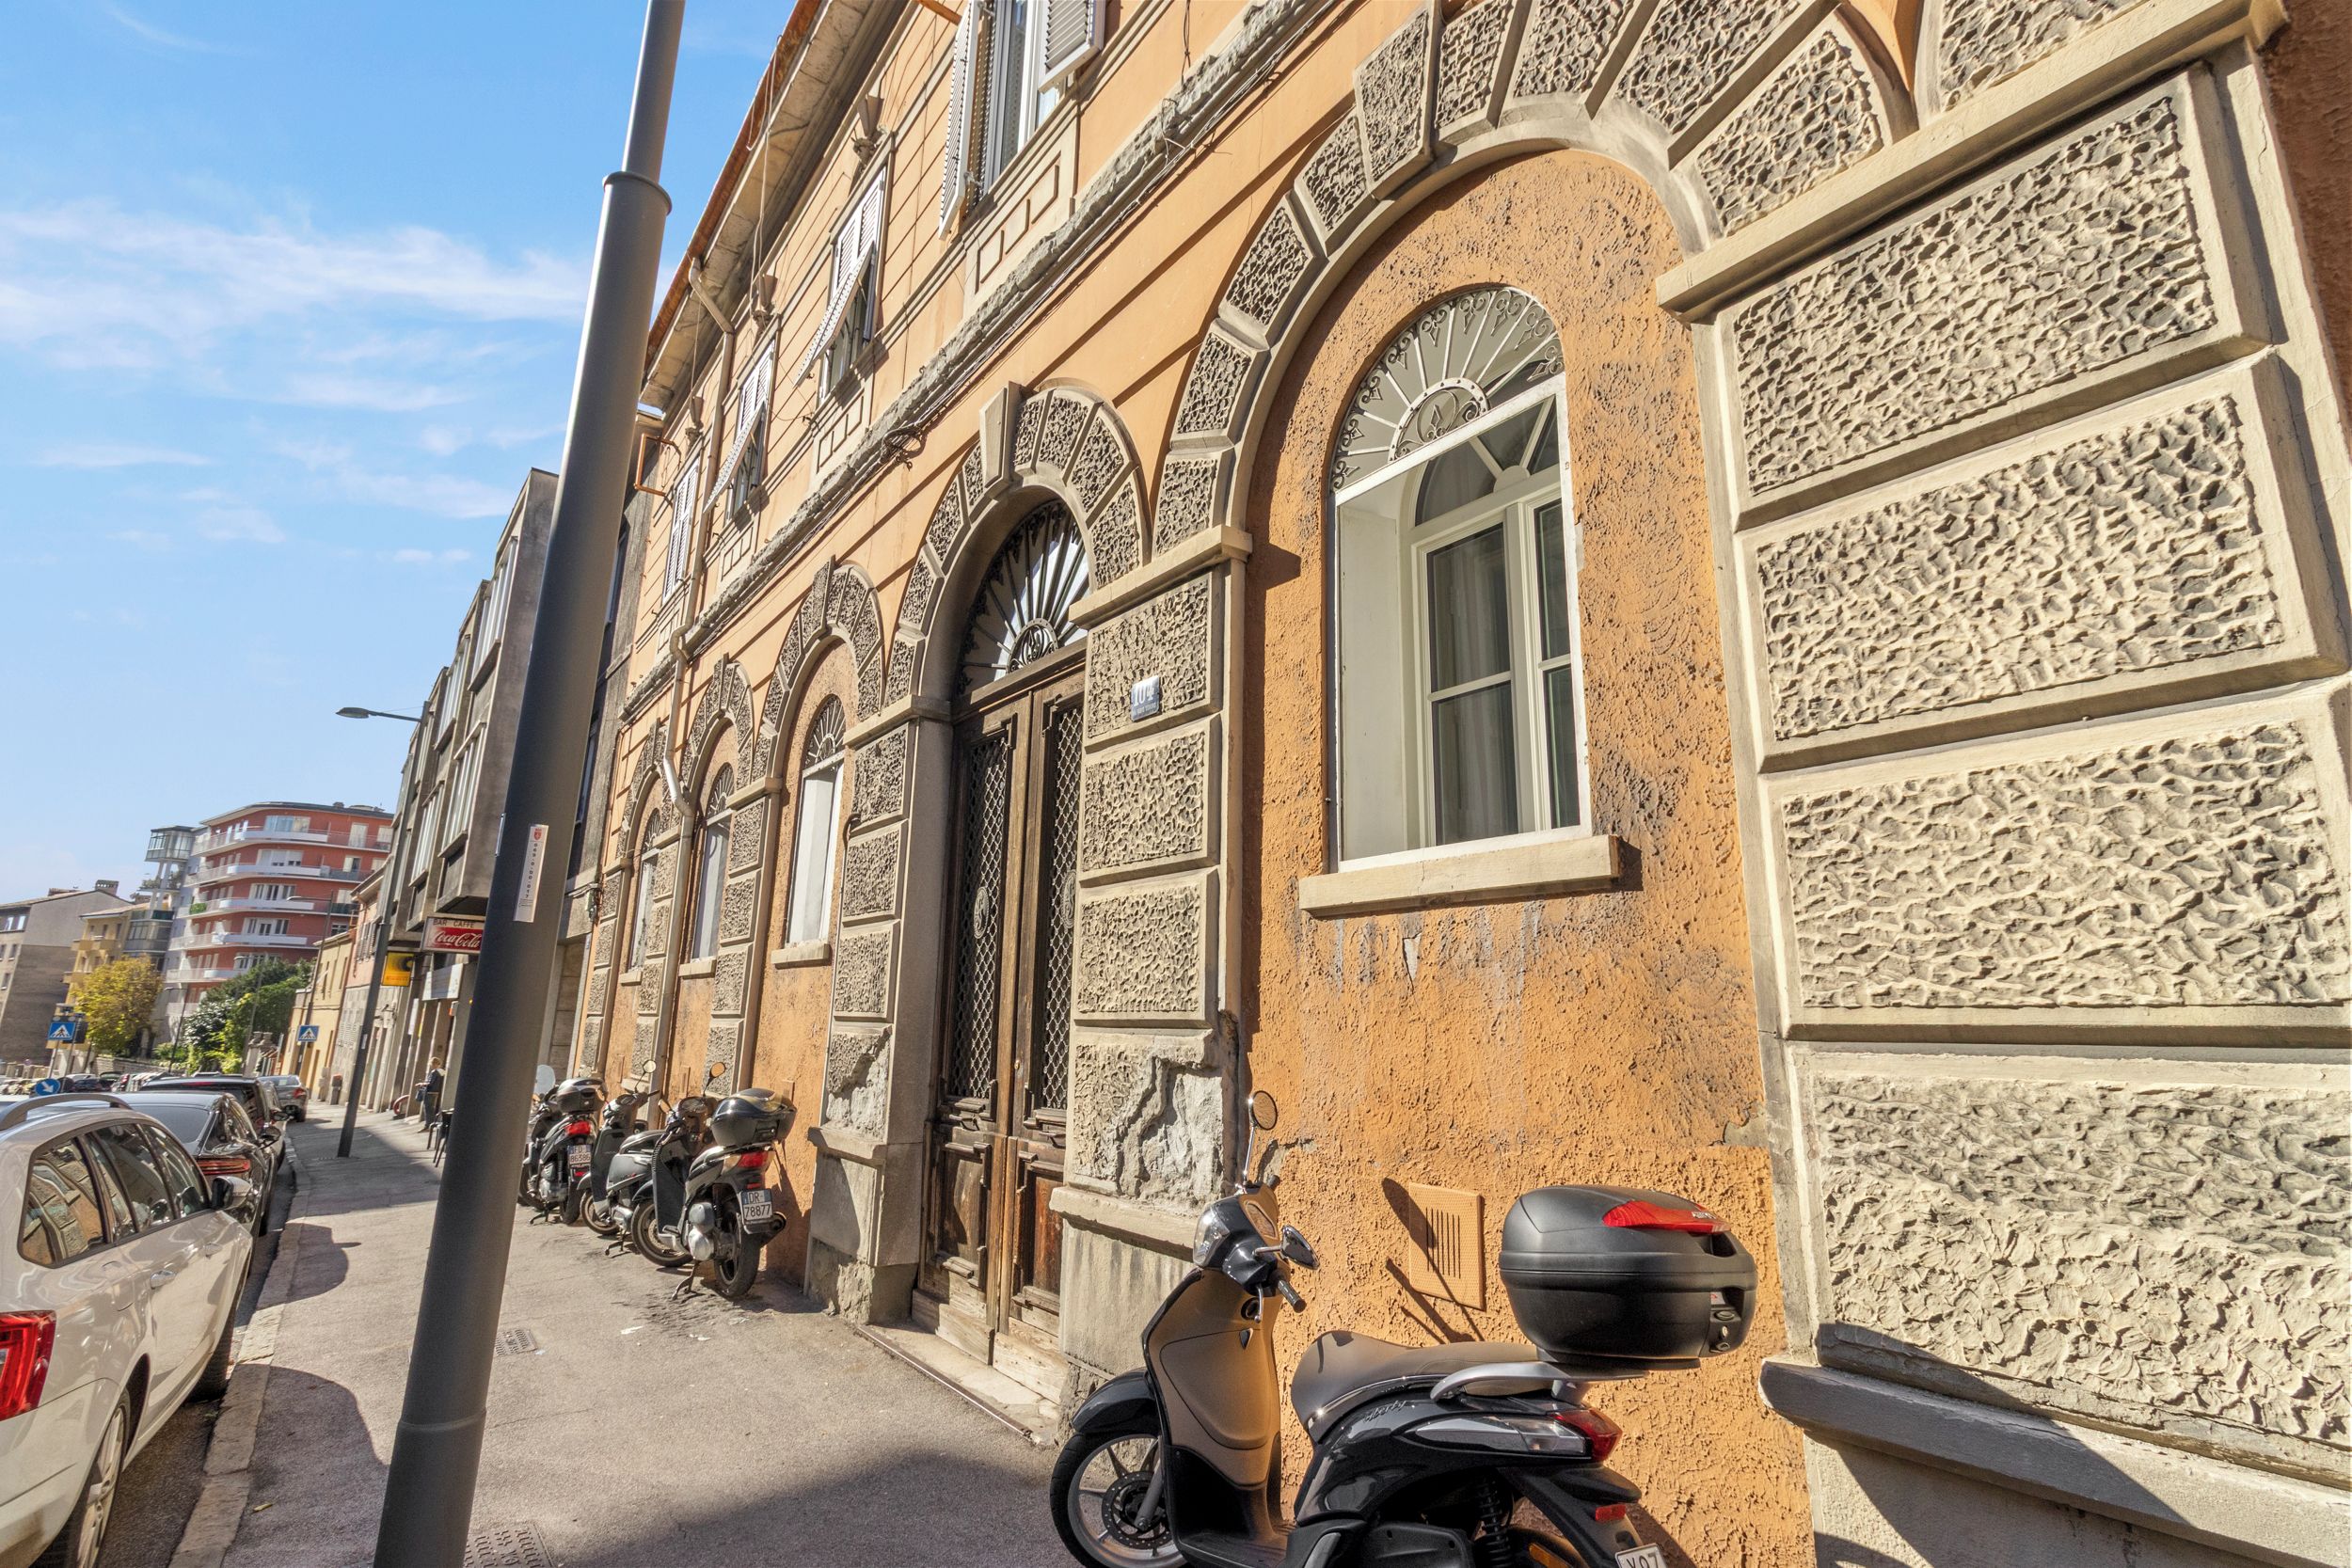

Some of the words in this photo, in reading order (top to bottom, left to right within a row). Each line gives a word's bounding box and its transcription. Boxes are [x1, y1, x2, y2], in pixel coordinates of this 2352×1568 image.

[433, 918, 447, 927] BAR
[748, 1191, 760, 1203] DR
[744, 1204, 771, 1218] 78877
